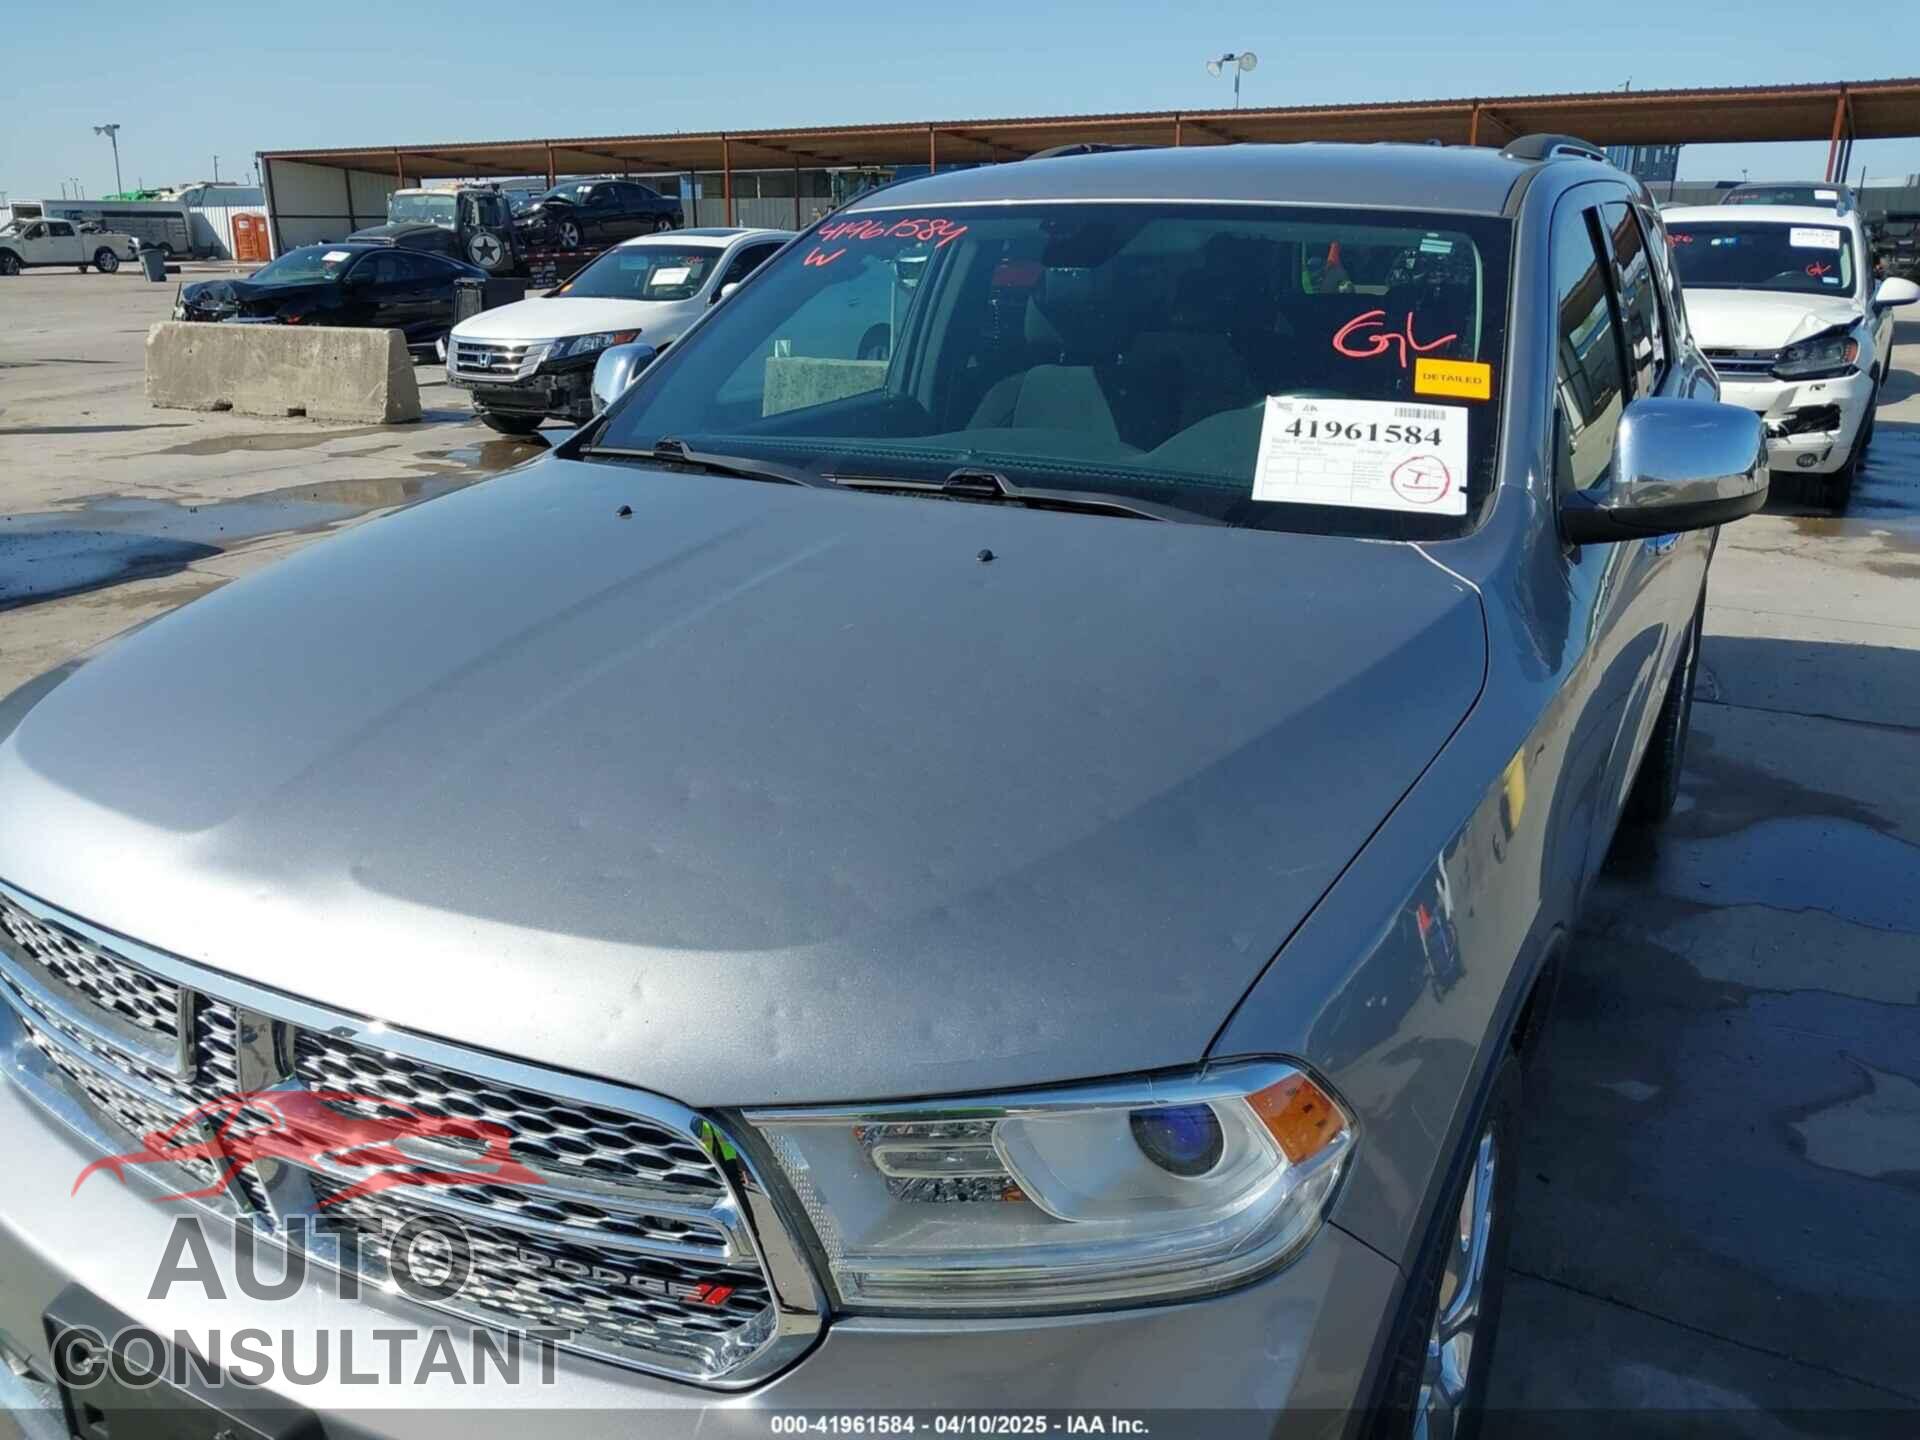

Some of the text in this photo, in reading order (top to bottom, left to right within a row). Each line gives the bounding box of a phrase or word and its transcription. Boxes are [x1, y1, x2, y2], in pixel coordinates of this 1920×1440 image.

[1422, 372, 1483, 385] DETAILED
[1284, 417, 1443, 447] 41961584
[516, 1246, 701, 1300] DODGE
